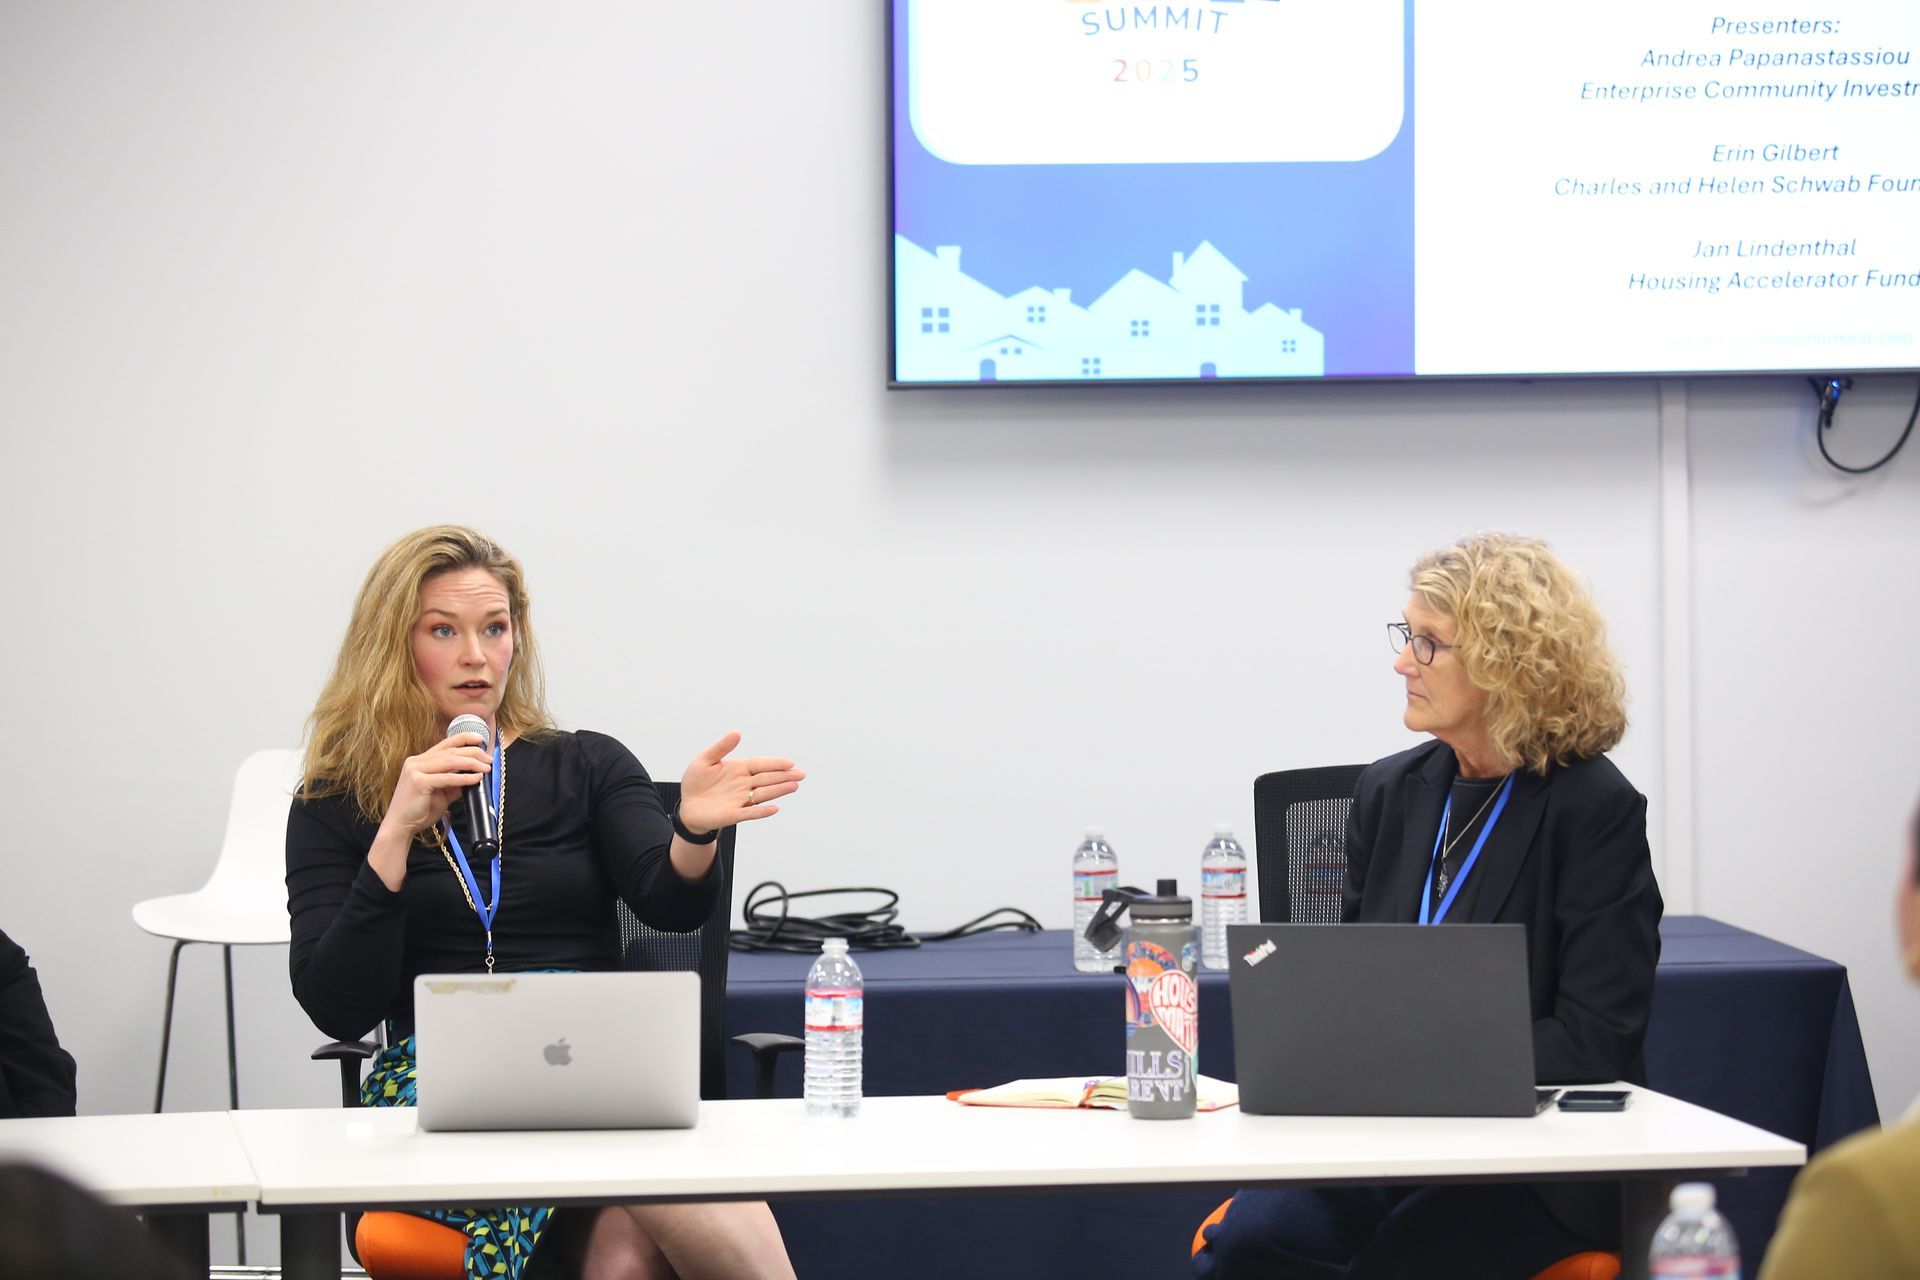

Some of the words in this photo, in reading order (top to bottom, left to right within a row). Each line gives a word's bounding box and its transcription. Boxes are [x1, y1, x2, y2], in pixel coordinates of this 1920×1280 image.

[1081, 6, 1229, 36] SUMMIT
[1712, 16, 1841, 35] Presenters:
[1641, 49, 1721, 67] Andrea
[1729, 47, 1910, 70] Papanastassiou
[1113, 58, 1199, 83] 2025
[1581, 82, 1696, 103] Enterprise
[1704, 80, 1838, 102] Community
[1713, 144, 1754, 162] Erin
[1762, 144, 1840, 162] Gilbert
[1555, 178, 1641, 195] Charles
[1649, 177, 1691, 194] and
[1699, 176, 1764, 193] Helen
[1772, 175, 1862, 193] Schwab
[1692, 240, 1729, 257] Jan
[1737, 238, 1856, 257] Lindenthal
[1629, 273, 1720, 294] Housing
[1727, 272, 1859, 288] Accelerator
[1865, 269, 1920, 287] Fund
